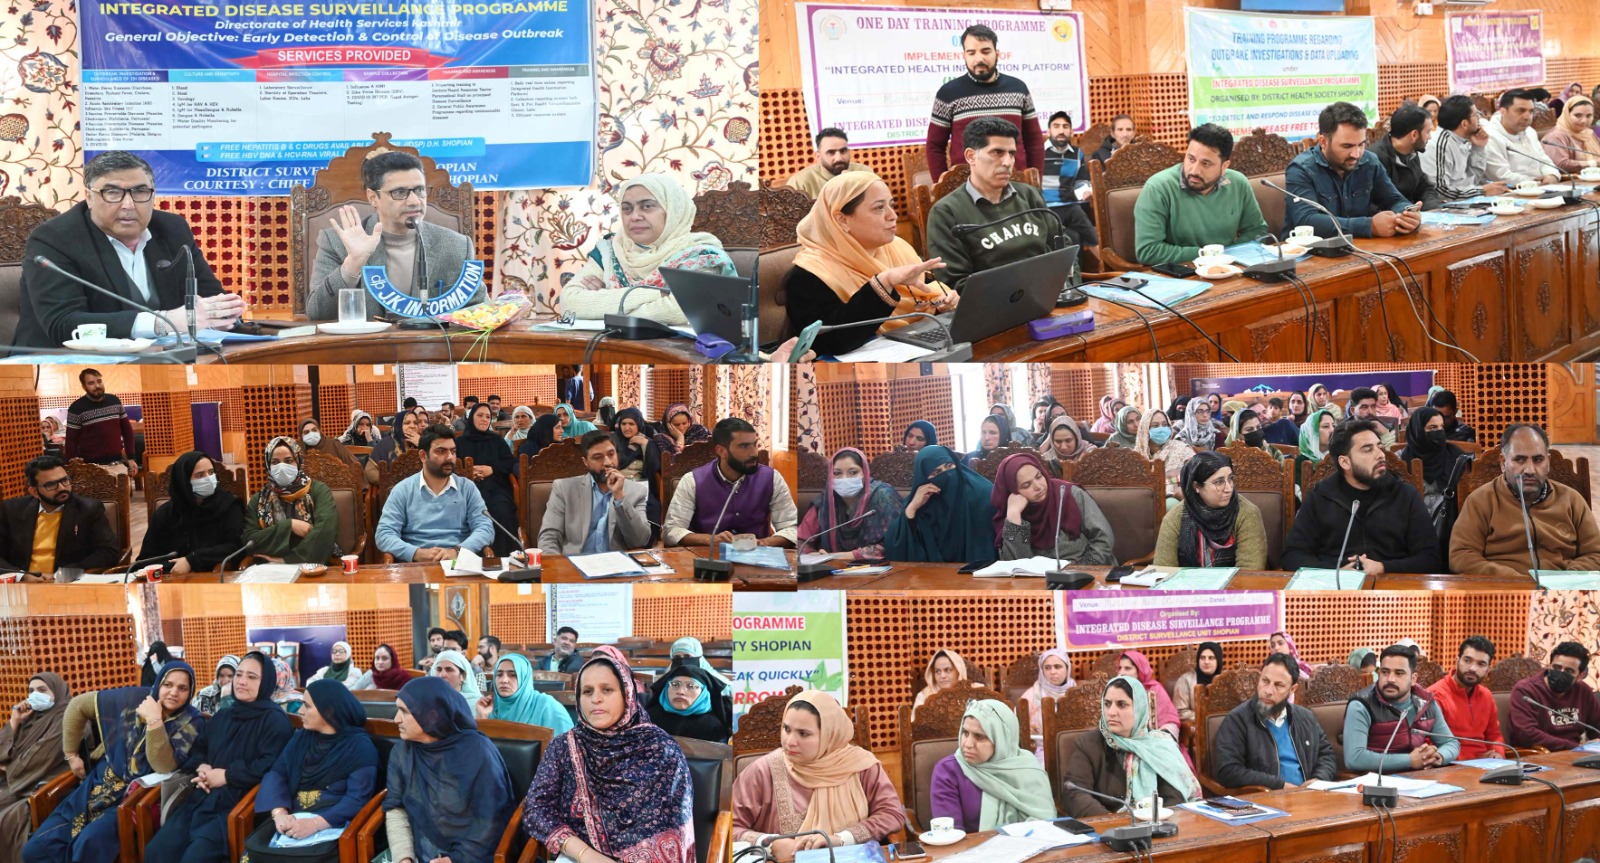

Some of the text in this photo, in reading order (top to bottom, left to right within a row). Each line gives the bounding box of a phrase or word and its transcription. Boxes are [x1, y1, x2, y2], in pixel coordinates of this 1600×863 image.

[100, 1, 568, 17] INTEGRATED DISEASE SURVEILLANCE PROGRAMME
[215, 18, 462, 30] Directorate of Health Services Kashmir
[856, 16, 883, 30] ONE
[888, 17, 910, 30] DAY
[914, 18, 972, 31] TRAINING
[105, 28, 564, 44] General Objective: Early Detection & Control of Disease Outbreak
[1232, 32, 1342, 45] TRAINING PROGRAMME REGARDING
[278, 50, 411, 62] SERVICES PROVIDED
[904, 52, 965, 60] IMPLEMENT
[1251, 49, 1303, 60] INVESTIGATIONS
[1311, 50, 1325, 60] DATA
[1326, 50, 1359, 60] UPLOADING
[908, 64, 950, 73] HEALTH
[1212, 76, 1360, 88] INTEGRATED DISEASE SURVEILLANCE PROGRAMME
[1211, 94, 1249, 103] ORGANISED
[834, 118, 929, 131] INTEGRATED DISE
[1291, 122, 1308, 131] FREE
[887, 130, 924, 138] DISTRICT
[206, 167, 272, 177] DISTRICT
[184, 180, 258, 190] COURTESY
[268, 179, 311, 189] CHIEF
[981, 222, 1040, 249] CHANGE
[403, 262, 482, 316] INFORMATION
[1076, 616, 1271, 634] INTEGRATED DISEASE SURVEILLANCE PROGRAMME
[1150, 631, 1196, 640] SURVEILLANCE
[751, 640, 811, 652] SHOPIAN
